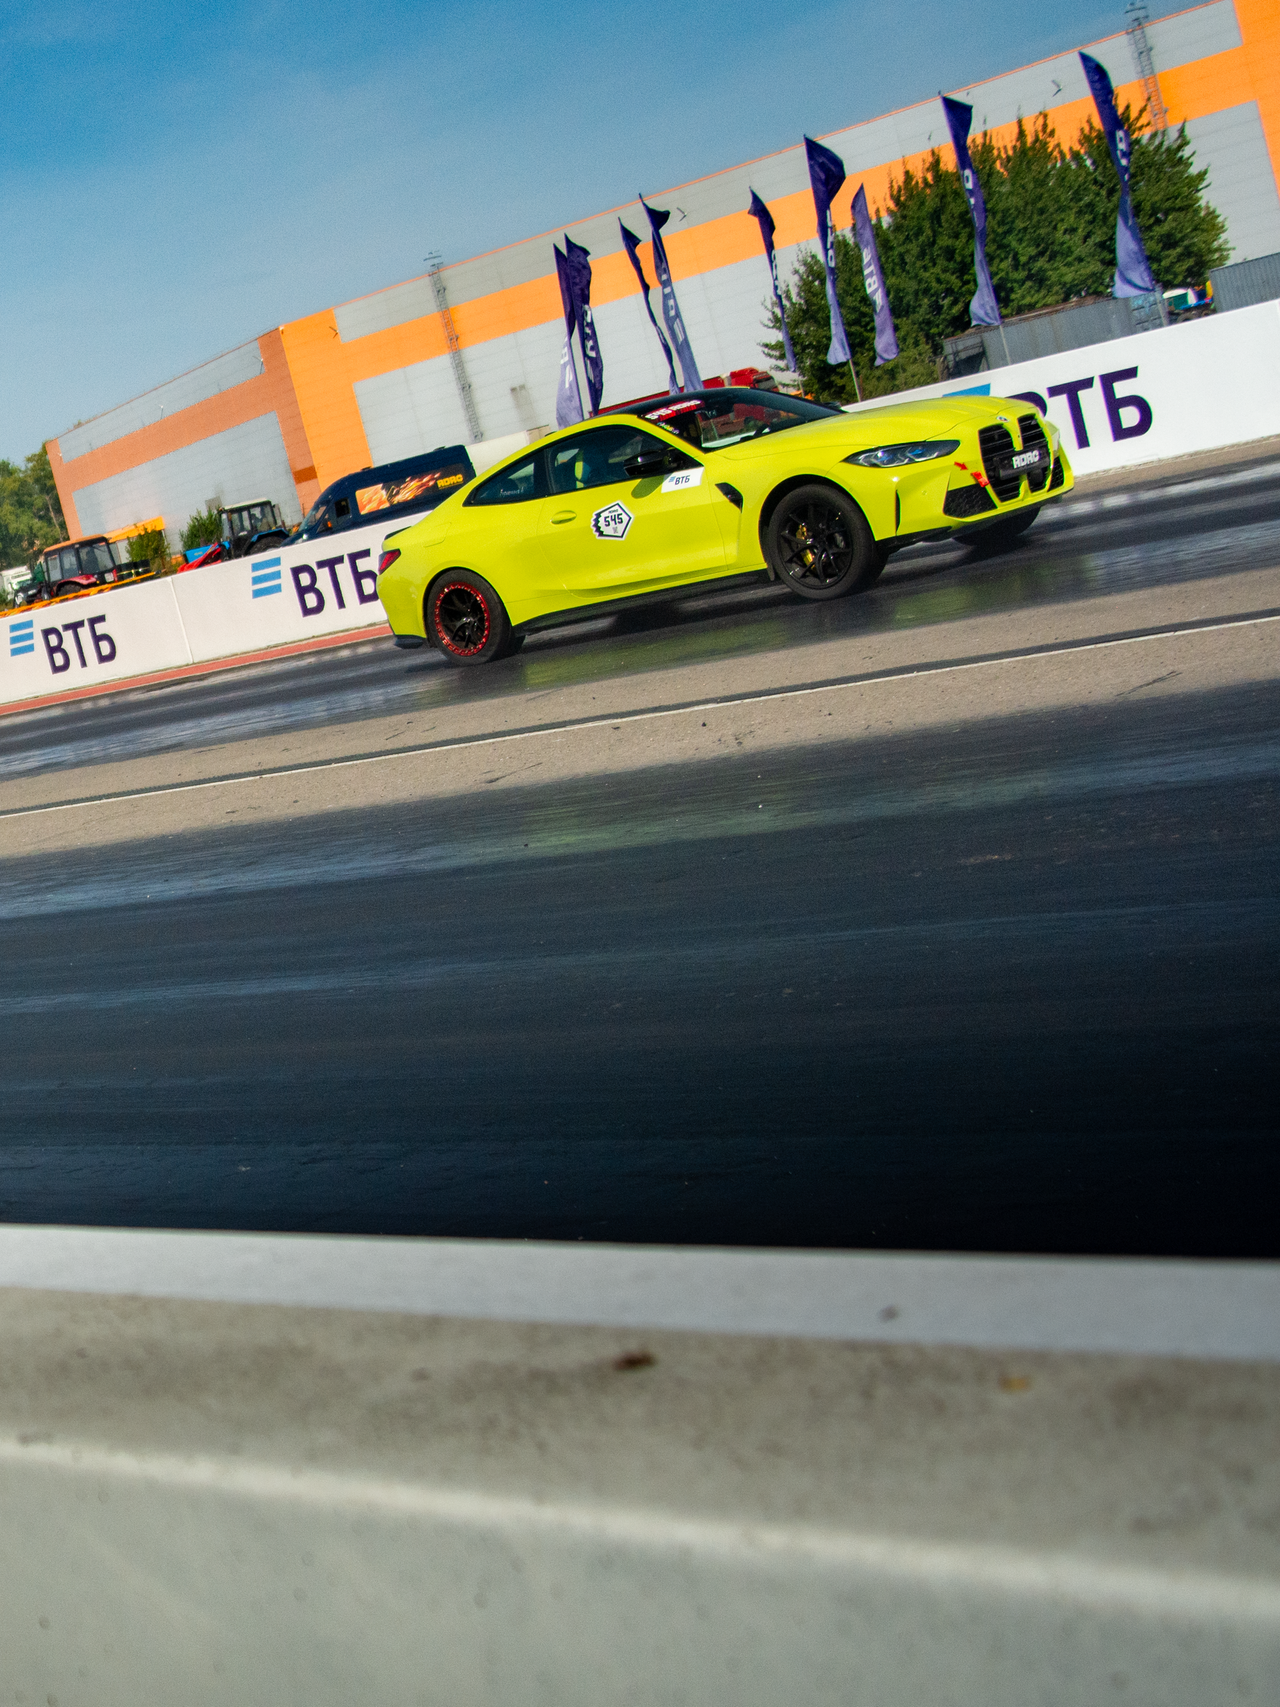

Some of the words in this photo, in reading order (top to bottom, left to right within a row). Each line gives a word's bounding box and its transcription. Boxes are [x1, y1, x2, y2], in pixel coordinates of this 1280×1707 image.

[1012, 449, 1040, 470] RDRC
[437, 474, 464, 489] RDRC
[674, 474, 691, 486] ВТБ
[604, 513, 624, 527] 545
[290, 549, 380, 618] ВТБ
[40, 614, 117, 675] ВТБ
